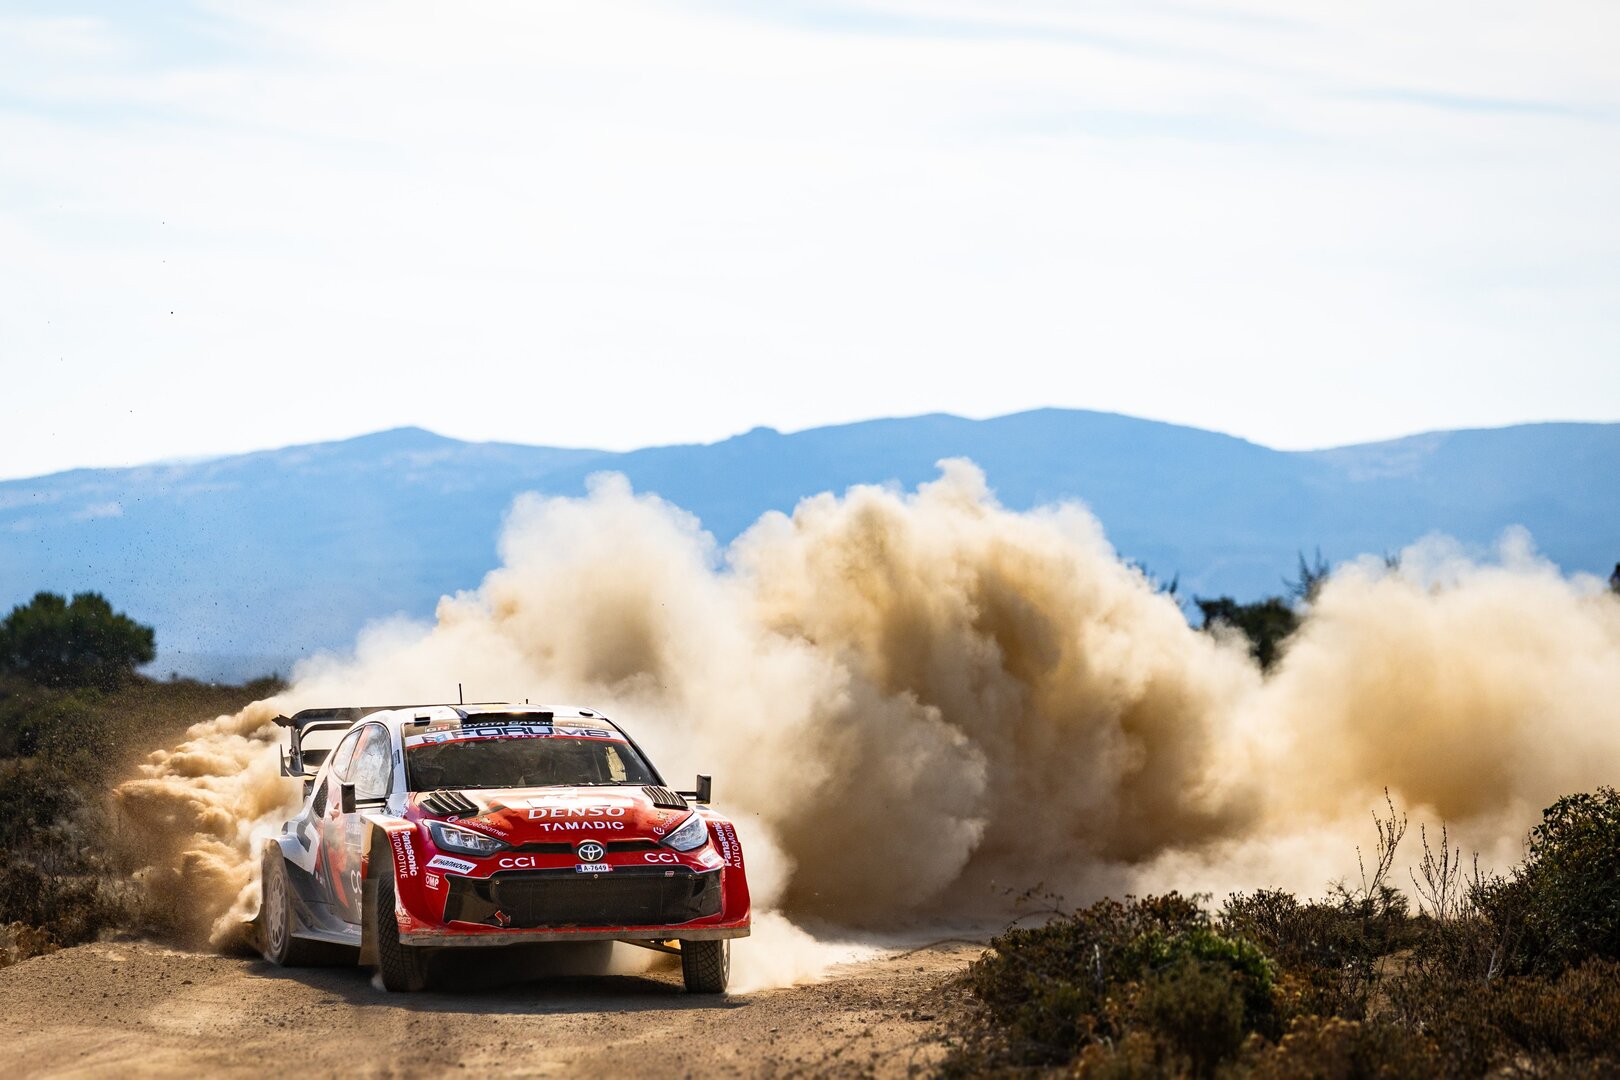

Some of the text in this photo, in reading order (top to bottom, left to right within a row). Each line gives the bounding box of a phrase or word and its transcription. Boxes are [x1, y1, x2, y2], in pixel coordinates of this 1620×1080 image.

[454, 721, 505, 729] TOYOTA
[451, 727, 611, 739] FORUM8
[528, 807, 625, 819] DENSO
[459, 818, 509, 837] codebeamer
[540, 821, 625, 832] TAMADIC
[392, 831, 409, 879] AUTOMOTIVE
[401, 831, 419, 876] Panasonic
[426, 875, 439, 887] OMP
